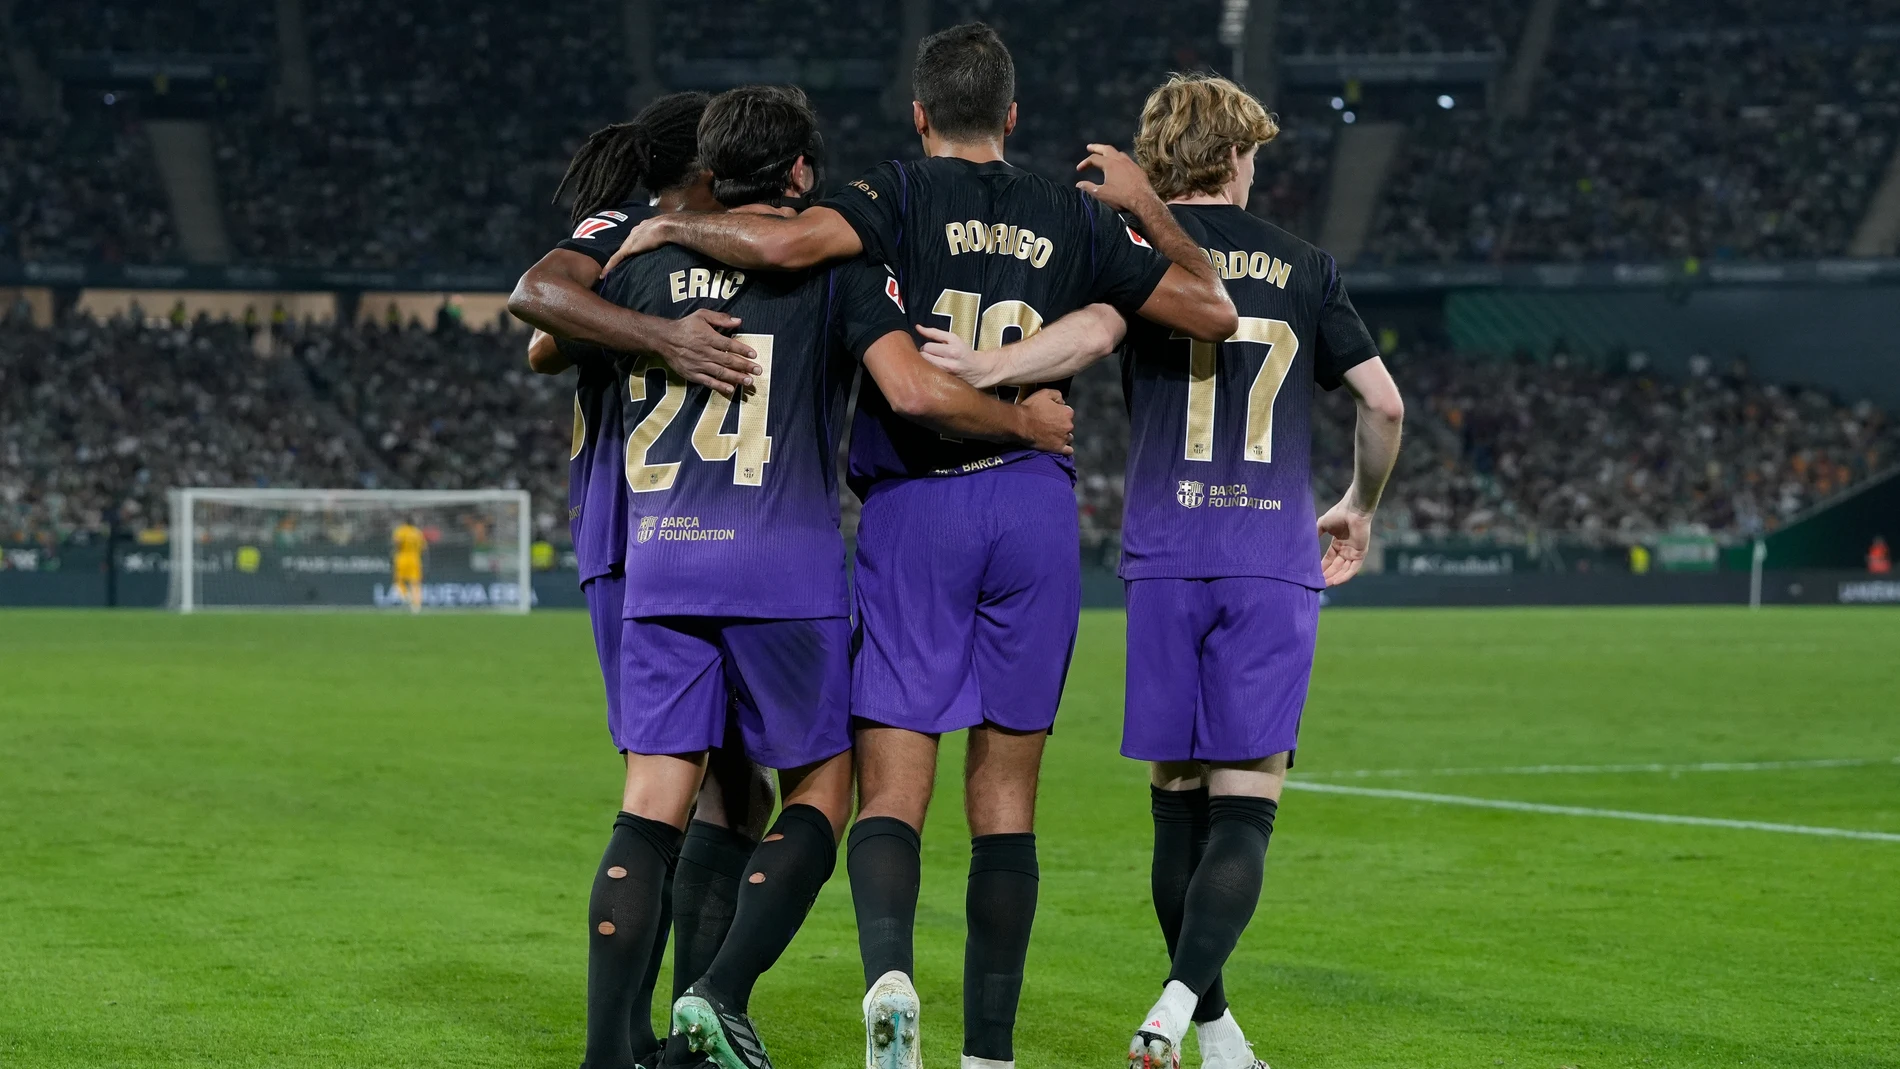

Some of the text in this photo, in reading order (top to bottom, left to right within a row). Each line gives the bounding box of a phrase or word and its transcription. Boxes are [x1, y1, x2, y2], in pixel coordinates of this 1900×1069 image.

[847, 179, 879, 200] dea
[1198, 246, 1293, 290] RDON
[669, 267, 746, 304] ERIC
[1168, 315, 1300, 464] 17
[625, 333, 774, 493] 24
[1209, 484, 1248, 498] BARÇA
[1208, 496, 1282, 511] FOUNDATION
[660, 516, 700, 530] BARÇA
[657, 529, 735, 541] FOUNDATION
